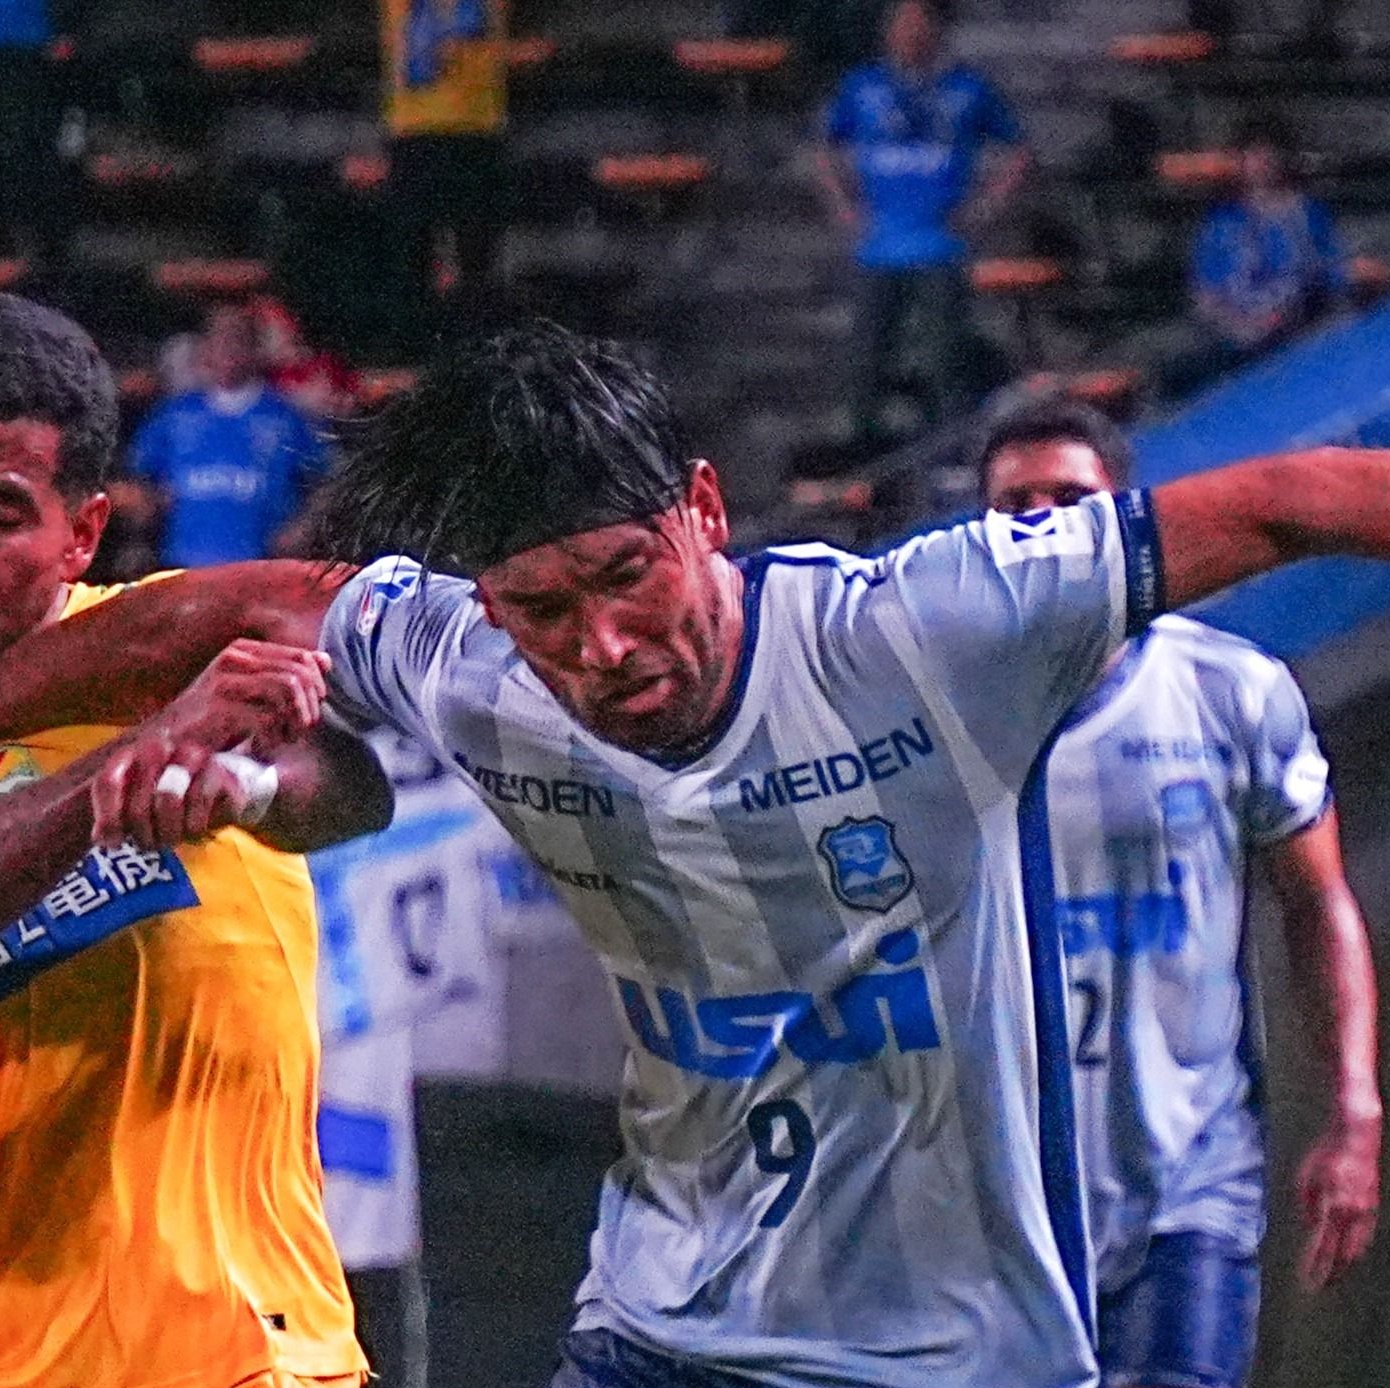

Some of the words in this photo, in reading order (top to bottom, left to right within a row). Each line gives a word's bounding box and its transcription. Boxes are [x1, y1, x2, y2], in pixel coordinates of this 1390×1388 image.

[739, 717, 934, 812] MEIDEN
[615, 927, 941, 1080] usui
[747, 1099, 817, 1228] 9
